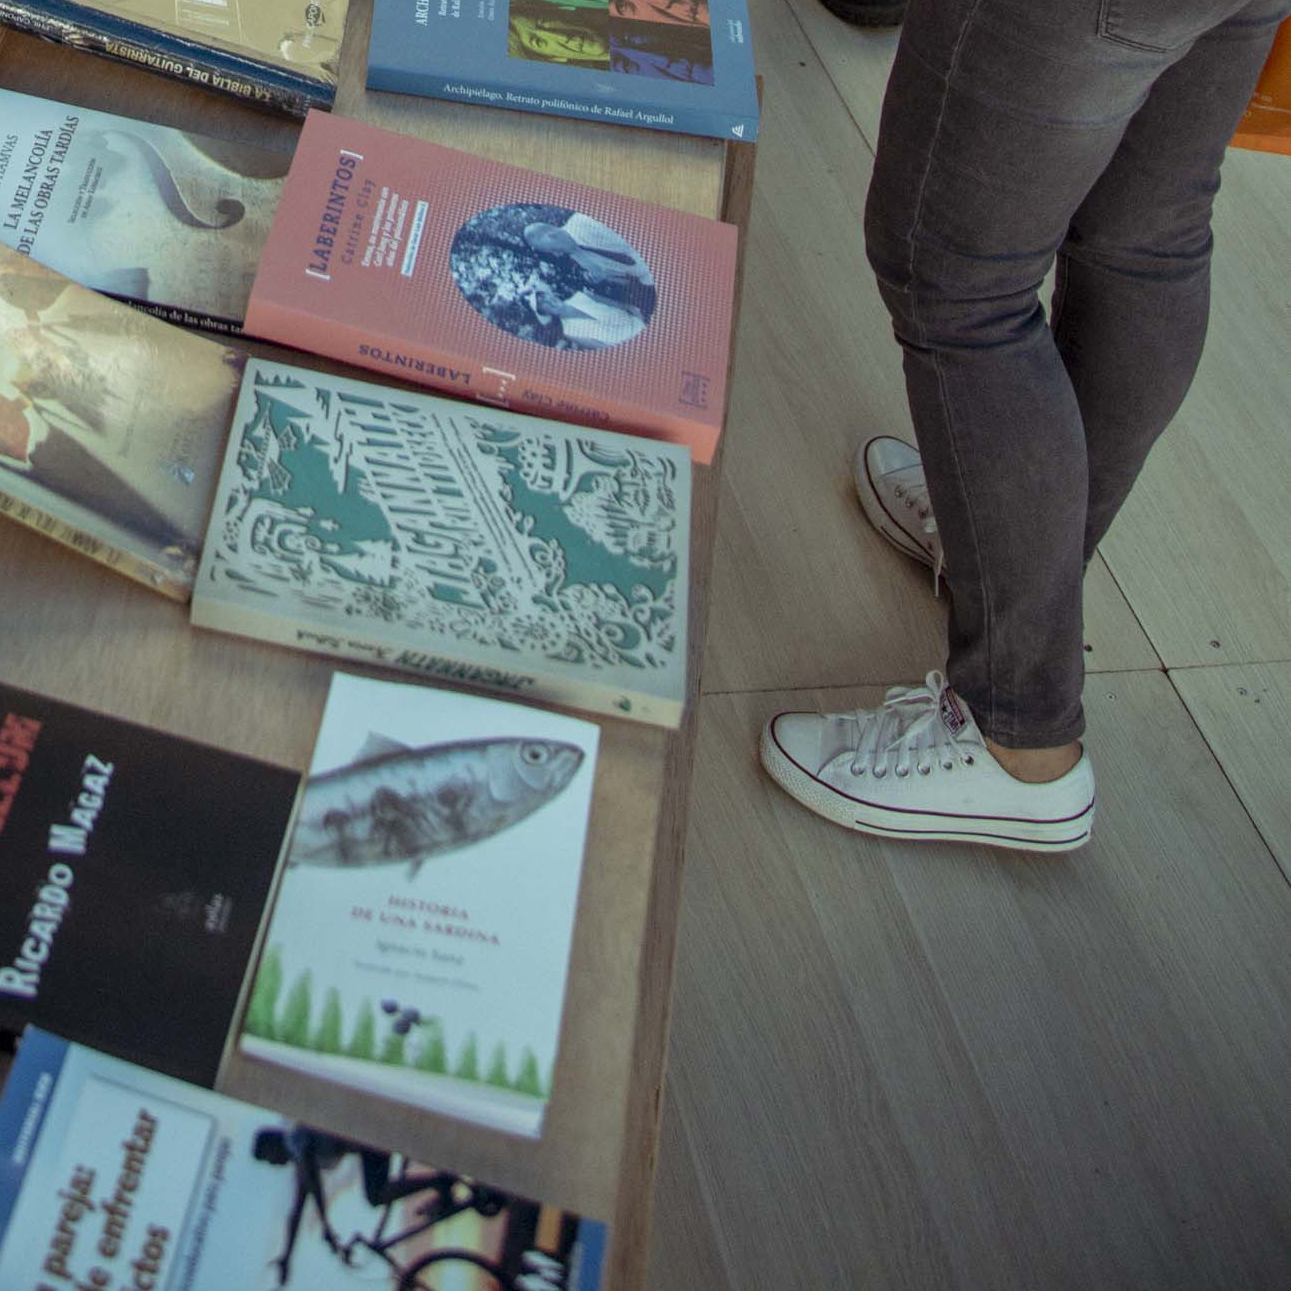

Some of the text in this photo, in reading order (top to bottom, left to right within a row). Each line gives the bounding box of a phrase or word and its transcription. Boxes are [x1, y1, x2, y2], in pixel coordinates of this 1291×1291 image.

[104, 42, 184, 76] GUITARRISTA
[185, 66, 210, 85] DEL
[211, 75, 254, 98] BIBLIA
[506, 91, 674, 125] Retrato polifónico de Rafael Argullol
[3, 129, 54, 231] LA MELANCOLÍA
[16, 114, 80, 256] DE LAS OBRAS TARDÍAS
[341, 178, 376, 264] Catrine Clay
[169, 309, 229, 331] de las obras
[358, 343, 472, 386] LABERINTOS
[522, 387, 552, 408] Clay
[350, 906, 501, 946] DE UNA SARDINA
[388, 894, 469, 921] HISTORIA
[96, 1107, 160, 1247] enfrentar
[43, 1166, 98, 1281] pareja:
